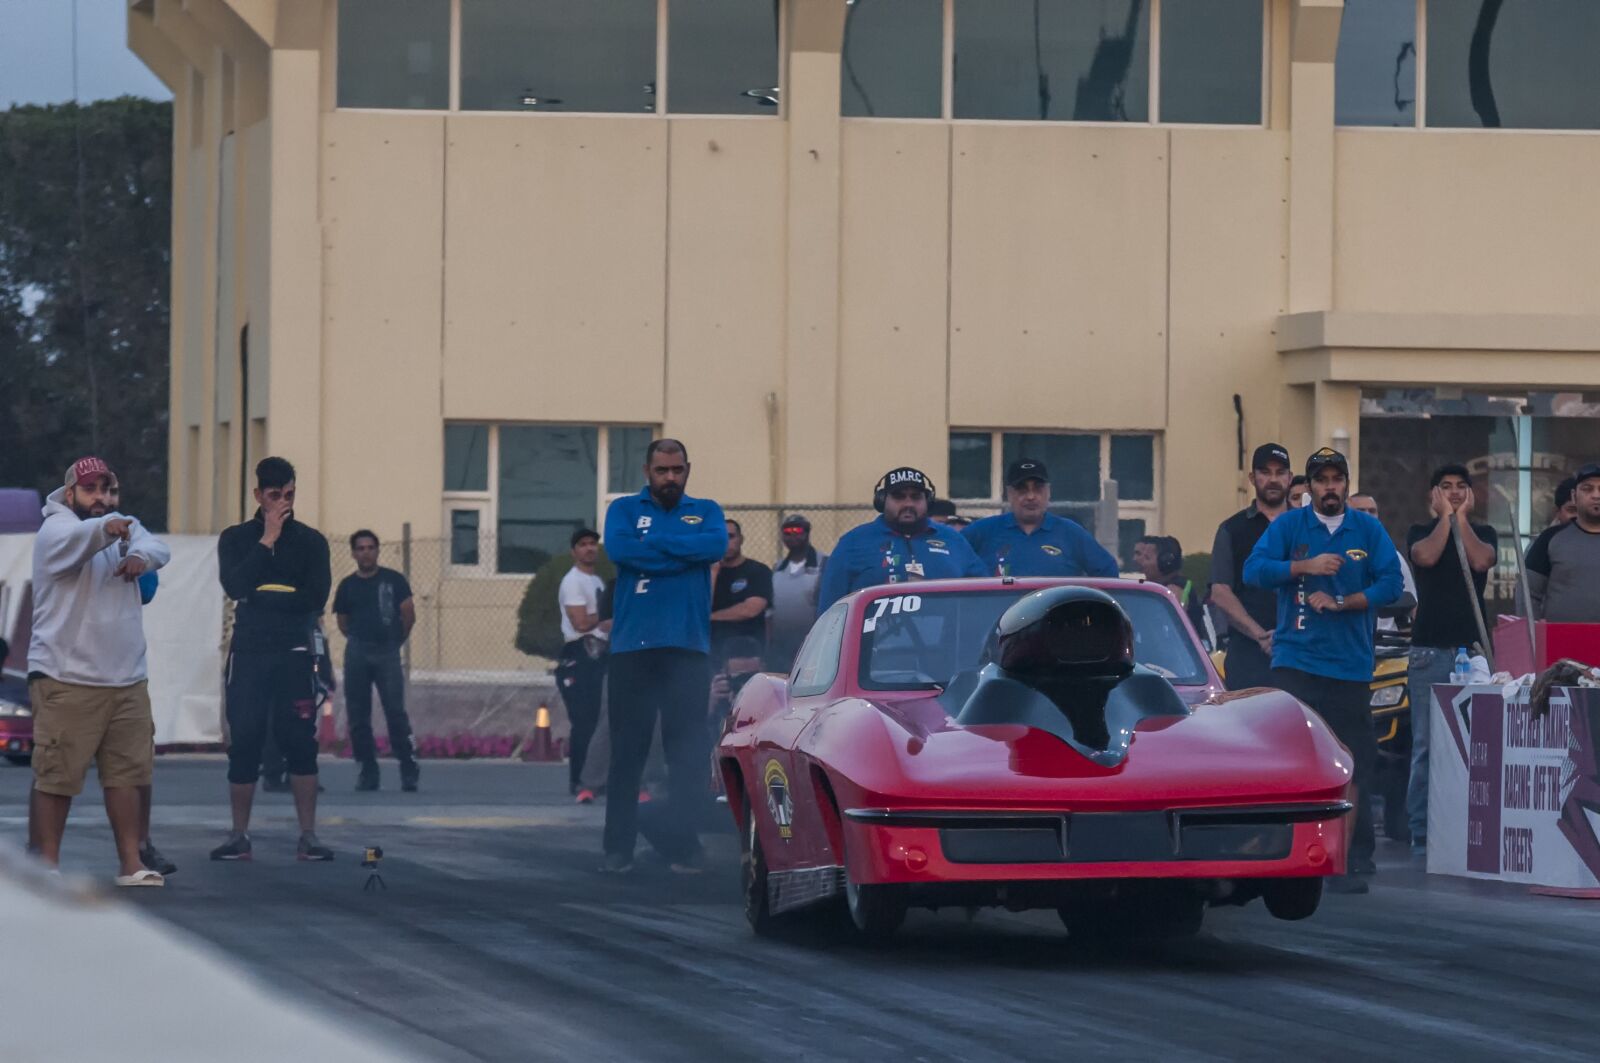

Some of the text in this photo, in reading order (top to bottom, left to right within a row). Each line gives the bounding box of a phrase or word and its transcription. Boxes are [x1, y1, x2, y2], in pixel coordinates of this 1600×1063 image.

[874, 595, 921, 618] 710
[1504, 764, 1561, 812] RACING OFF THE
[1503, 826, 1533, 874] STREETS
